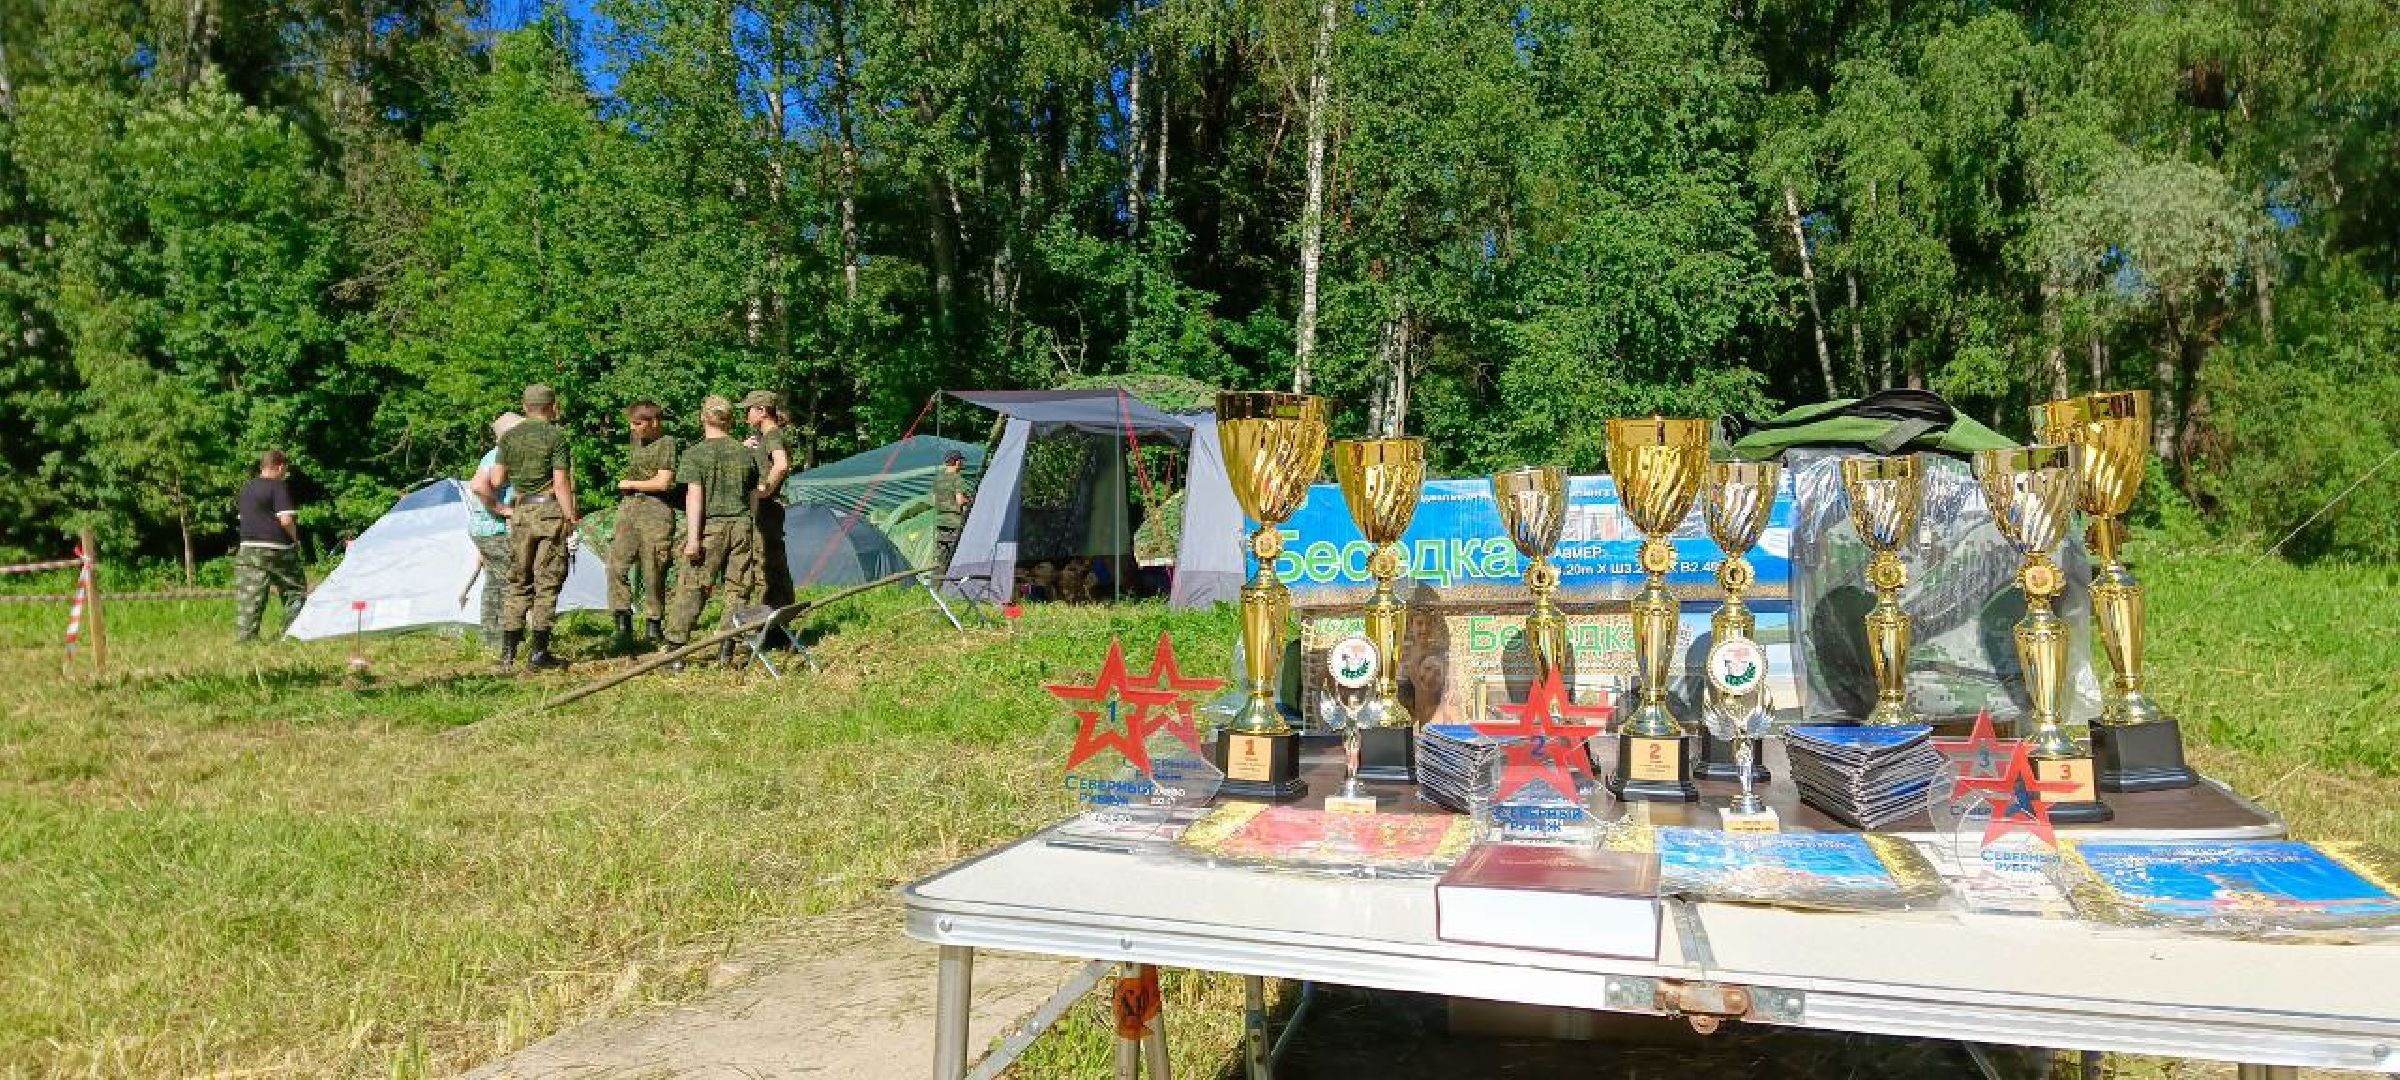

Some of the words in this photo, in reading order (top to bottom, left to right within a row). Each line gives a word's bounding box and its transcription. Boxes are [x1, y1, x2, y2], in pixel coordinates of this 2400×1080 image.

[1245, 738, 1256, 756] 1
[1649, 743, 1661, 760] 2
[2059, 764, 2072, 780] 3
[1980, 849, 2063, 864] СЕВЕРНЫЙ
